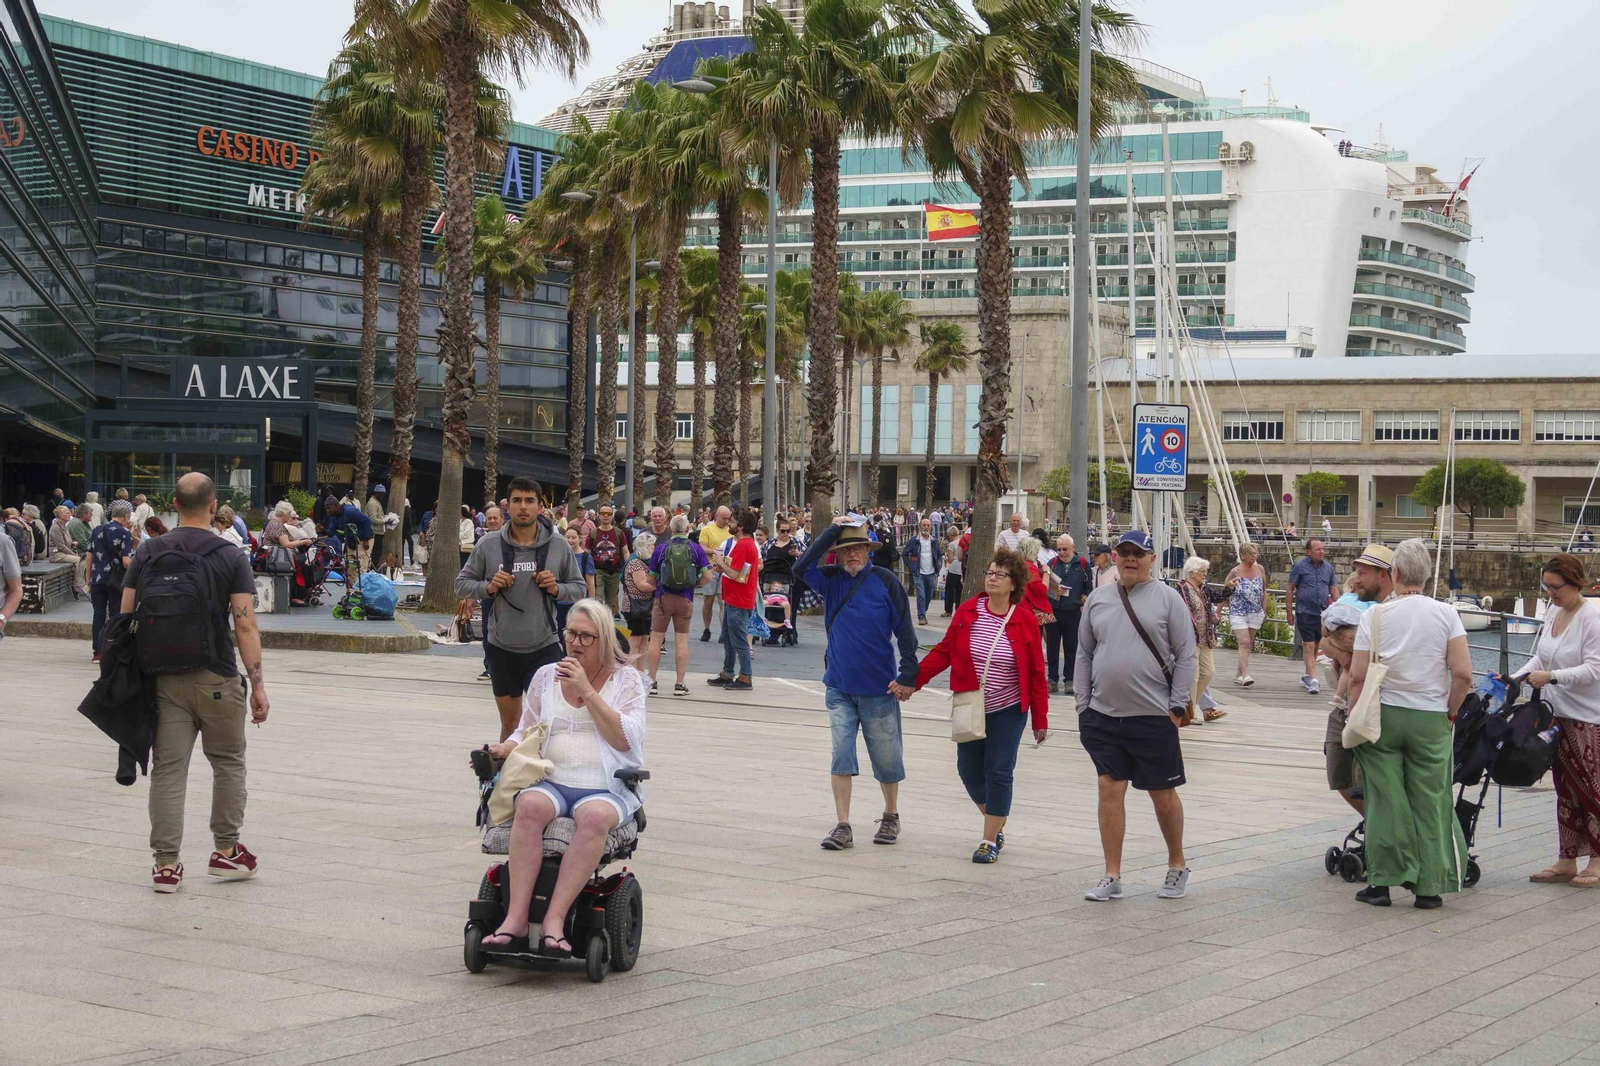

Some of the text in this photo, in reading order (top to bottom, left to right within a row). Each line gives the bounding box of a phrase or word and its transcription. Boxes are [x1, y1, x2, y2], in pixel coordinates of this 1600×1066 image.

[197, 125, 298, 170] CASINO
[184, 364, 300, 399] A LAXE
[1139, 415, 1185, 424] ATENCIÓN
[1166, 436, 1178, 446] 10
